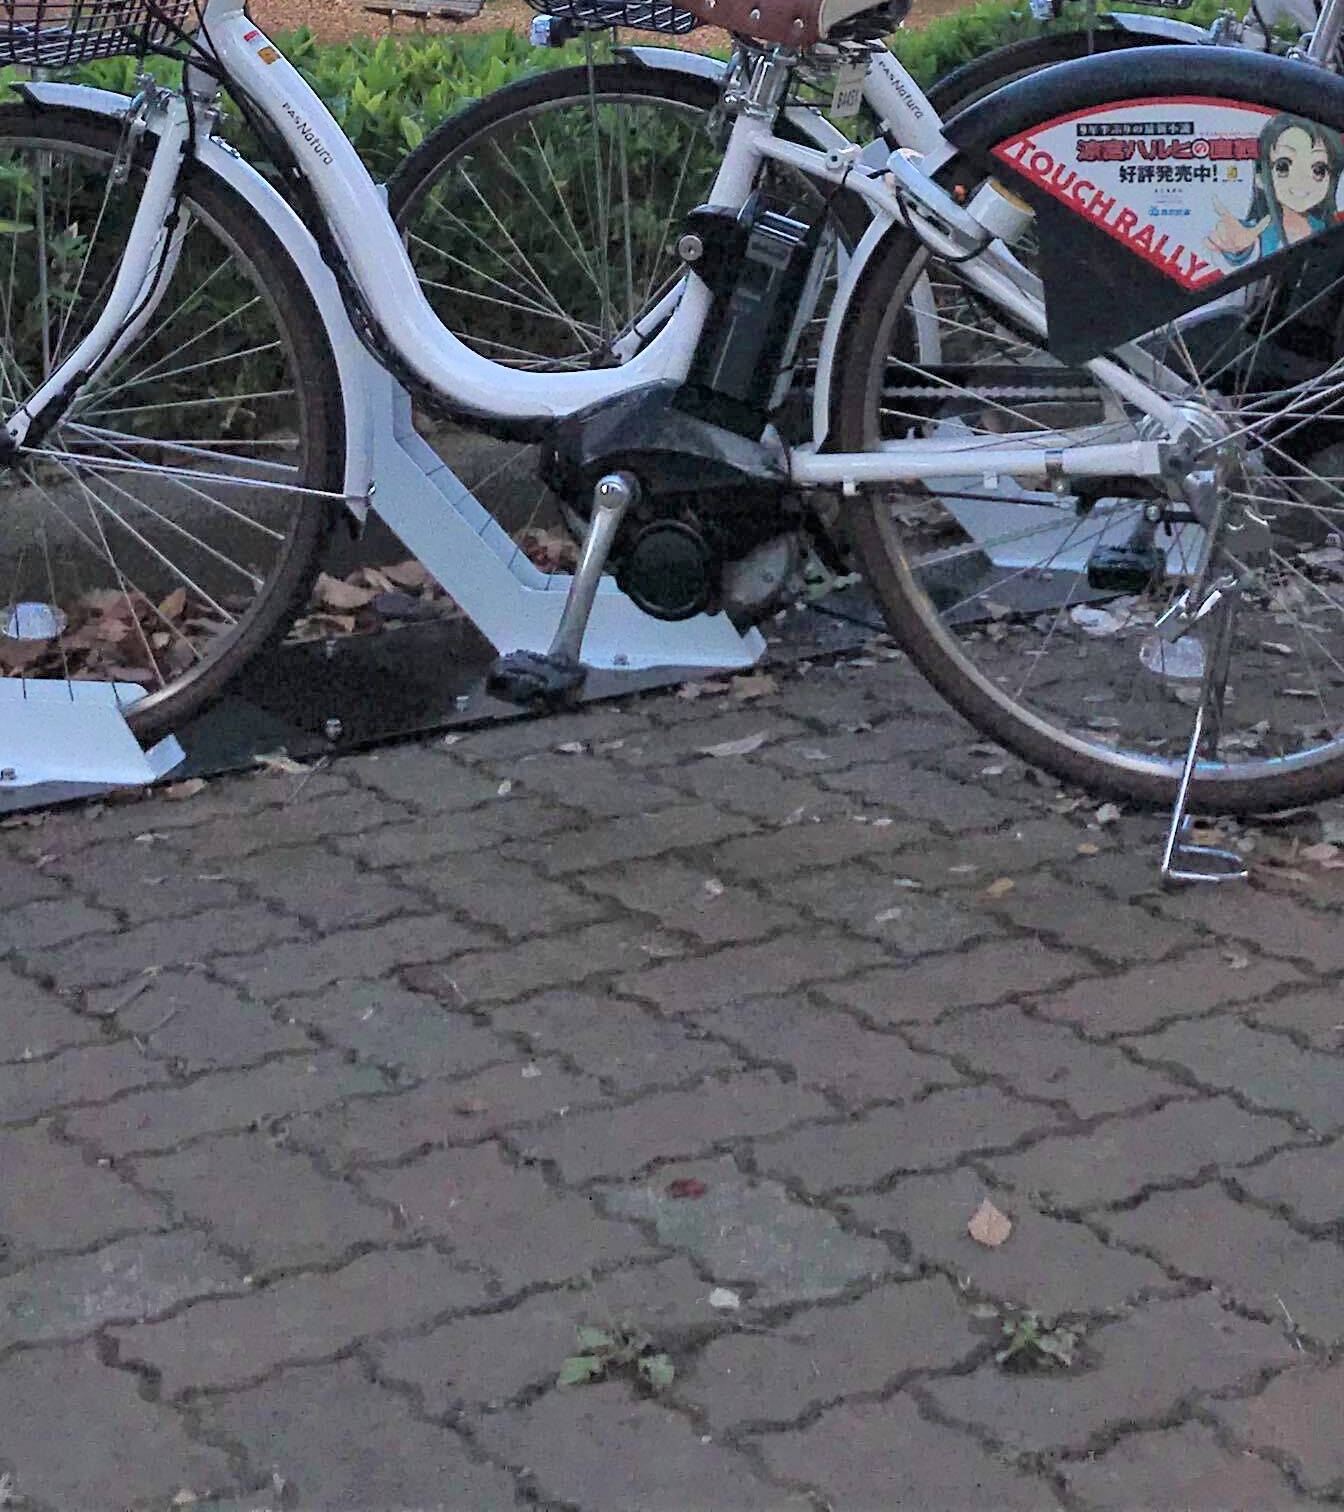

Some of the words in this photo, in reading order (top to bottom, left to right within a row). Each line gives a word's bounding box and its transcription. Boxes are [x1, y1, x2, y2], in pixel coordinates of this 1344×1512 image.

[891, 80, 924, 120] Natura
[282, 102, 300, 125] PAS
[296, 121, 334, 166] Natura
[1119, 165, 1218, 183] 好評発売中!
[1017, 138, 1117, 216] TOUCH
[1113, 207, 1209, 282] RALLY
